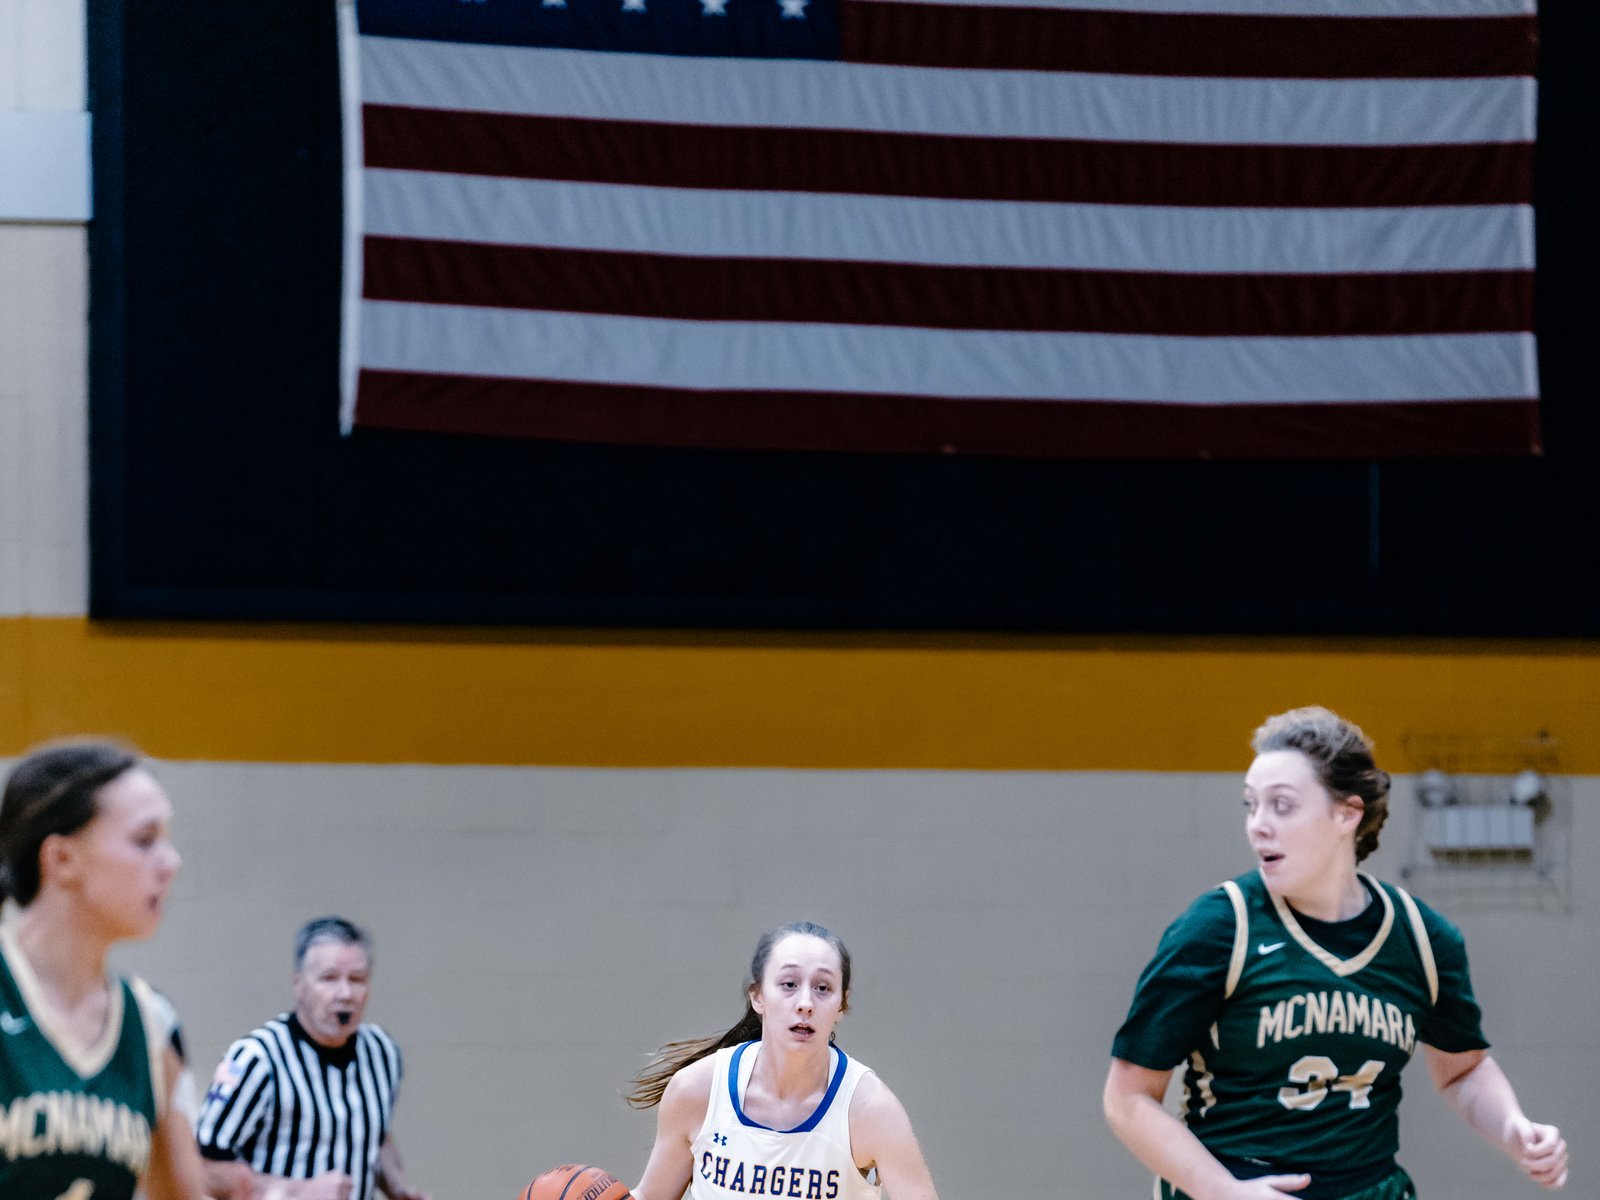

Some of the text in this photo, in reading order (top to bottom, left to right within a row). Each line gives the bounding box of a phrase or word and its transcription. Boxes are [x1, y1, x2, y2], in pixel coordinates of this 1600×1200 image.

[1256, 989, 1416, 1056] MCNAMARA
[1276, 1055, 1387, 1112] 34
[700, 1150, 841, 1200] CHARGERS
